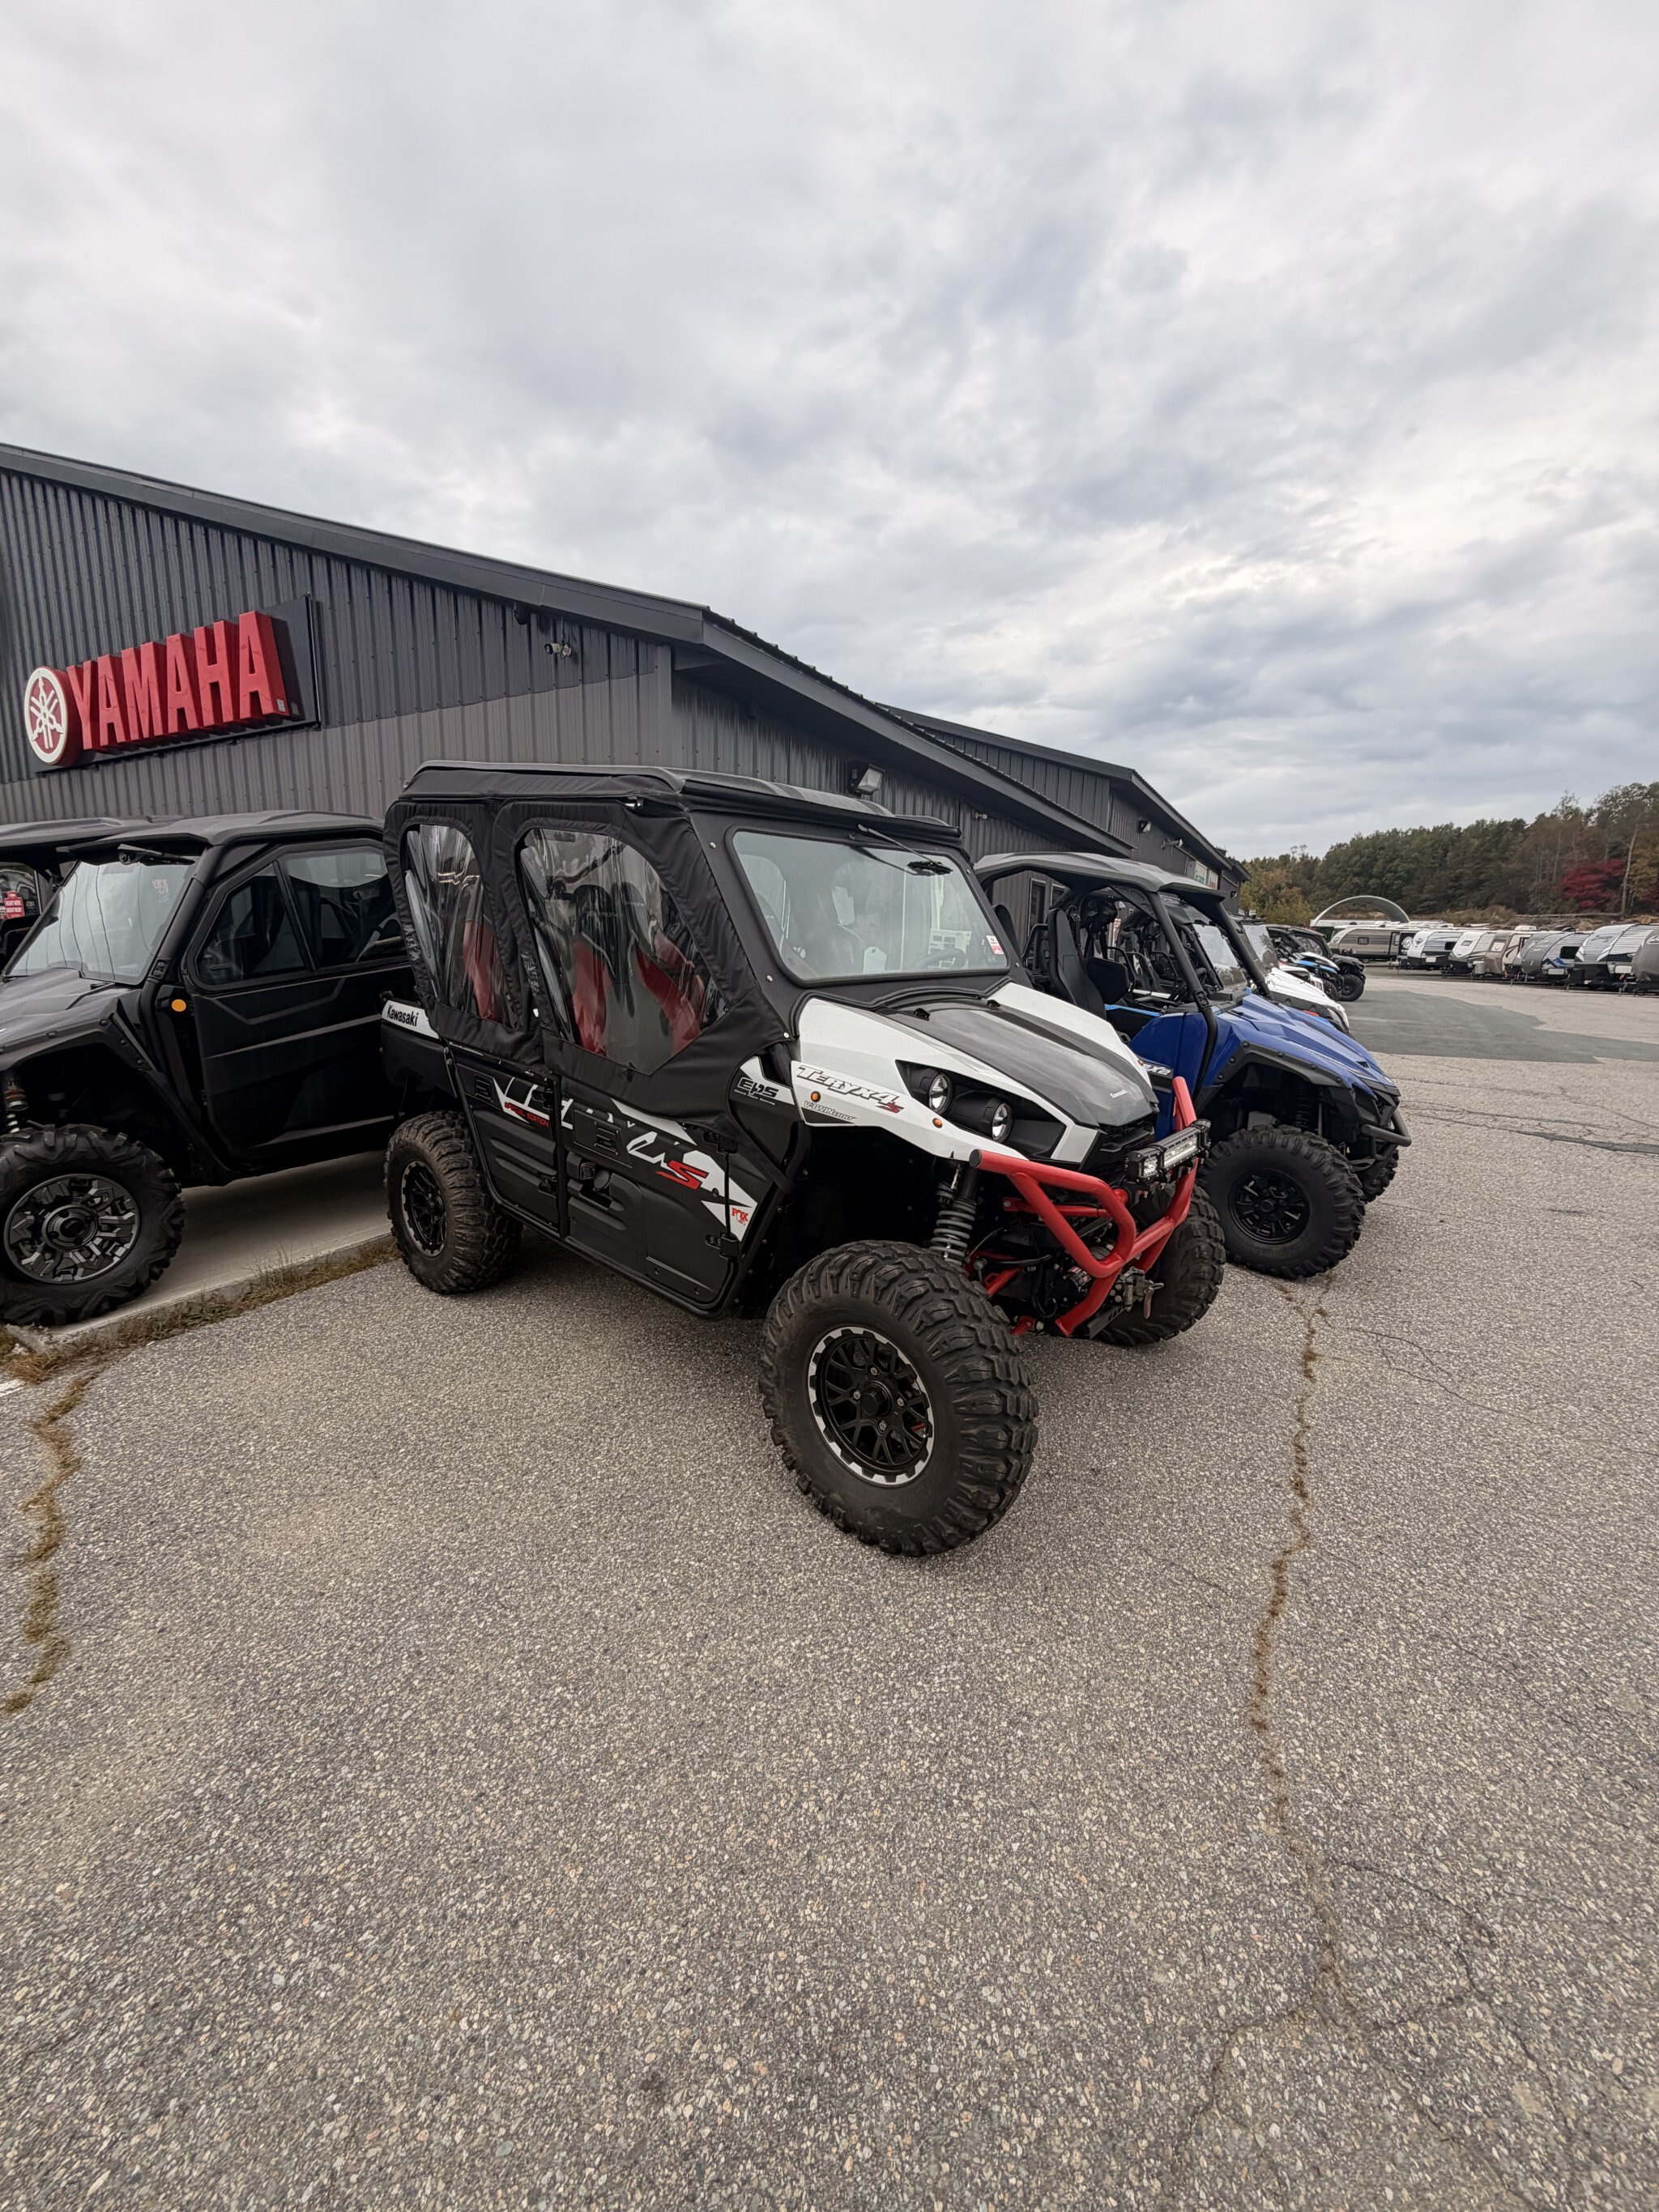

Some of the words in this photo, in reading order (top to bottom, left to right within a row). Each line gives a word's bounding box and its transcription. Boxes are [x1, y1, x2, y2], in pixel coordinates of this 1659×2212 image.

[66, 611, 278, 750] YAMAHA
[387, 1004, 419, 1027] Kawasaki
[737, 1077, 779, 1098] EPS
[731, 1207, 749, 1224] FOX
